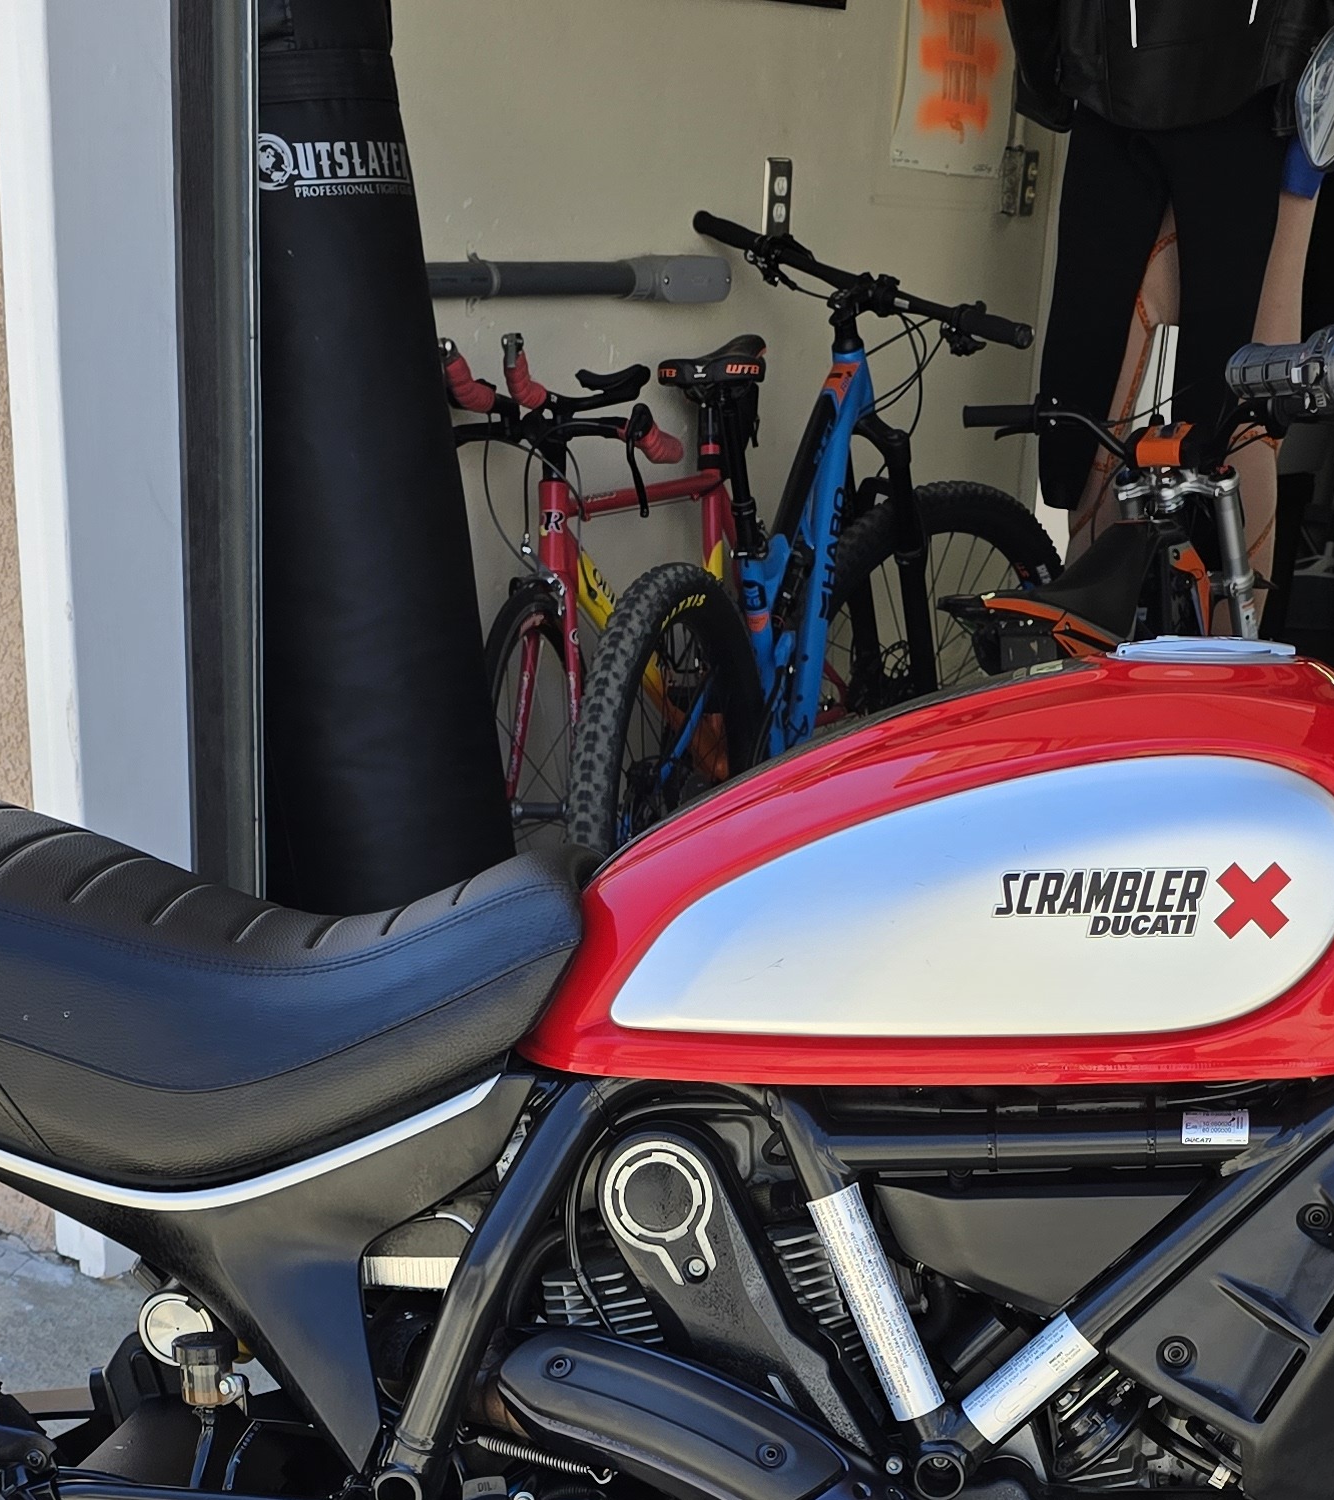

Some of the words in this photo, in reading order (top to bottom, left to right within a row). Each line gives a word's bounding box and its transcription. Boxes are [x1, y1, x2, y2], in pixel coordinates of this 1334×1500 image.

[295, 183, 373, 198] PROFESSIONAL
[725, 364, 760, 374] WTB
[994, 870, 1208, 916] SCRAMBLER
[1088, 914, 1198, 936] DUCATI
[477, 1481, 493, 1493] OIL
